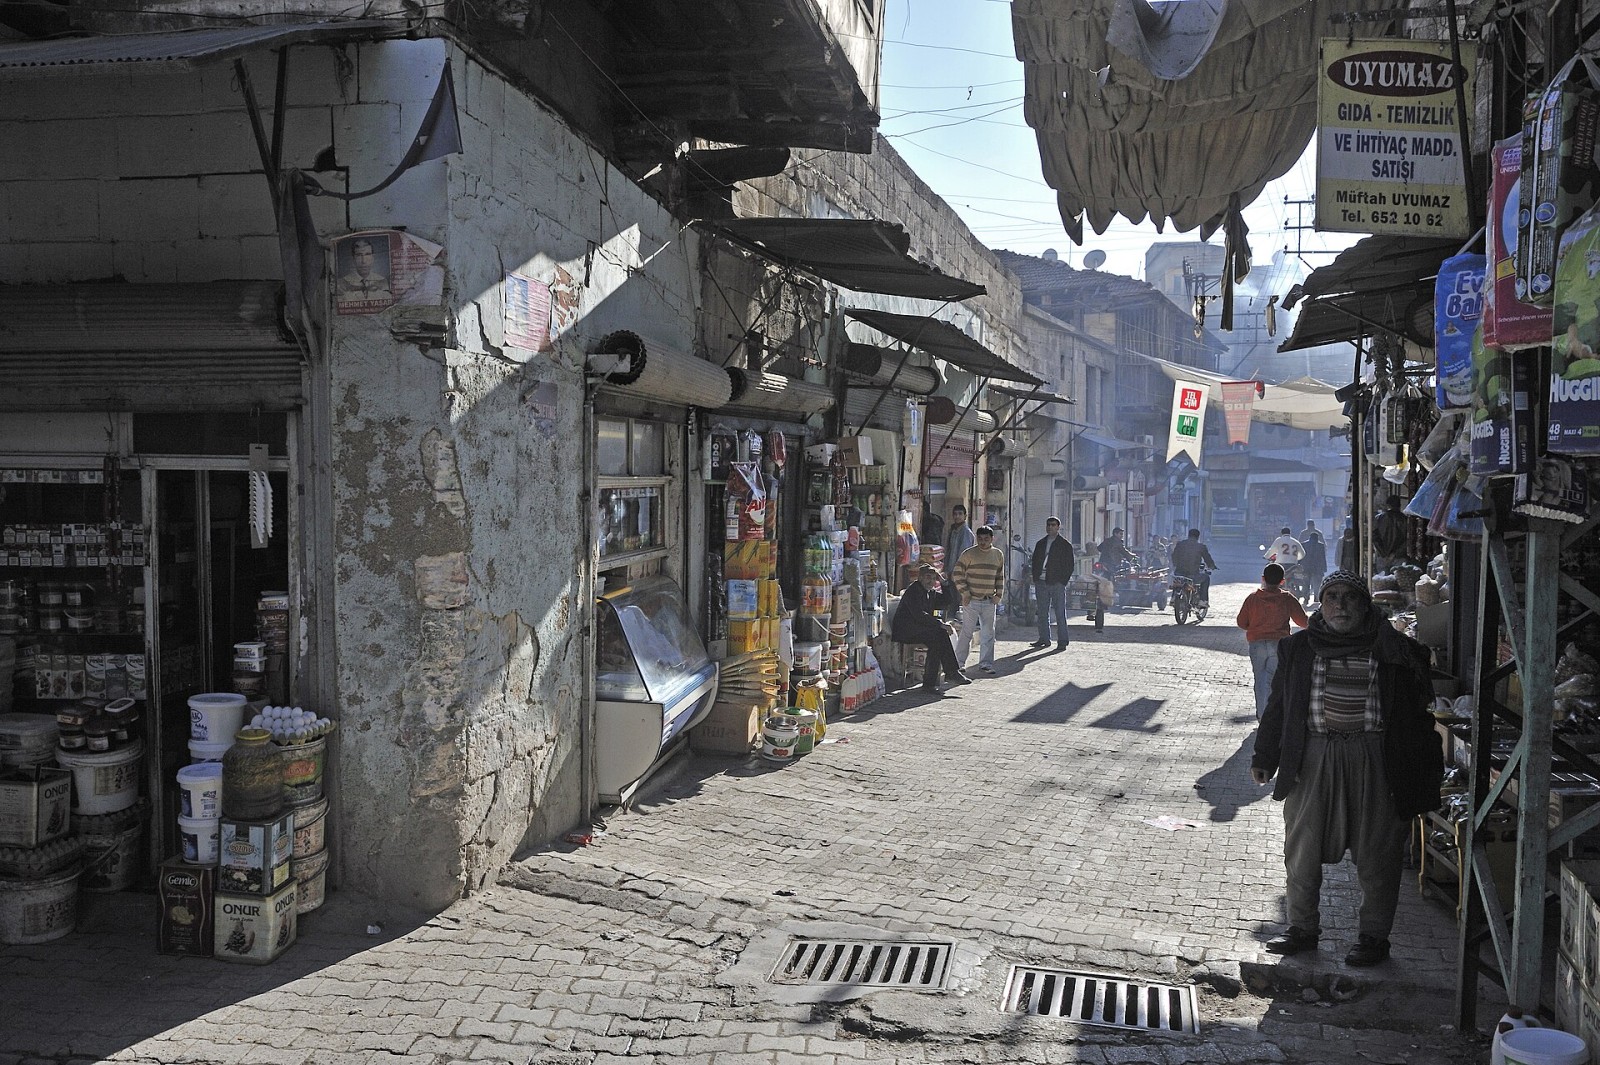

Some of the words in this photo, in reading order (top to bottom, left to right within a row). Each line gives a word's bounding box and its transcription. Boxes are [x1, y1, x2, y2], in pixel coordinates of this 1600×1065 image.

[1343, 60, 1455, 88] UYUMAZ
[1337, 103, 1373, 123] GIDA
[1387, 99, 1455, 126] TEMİZLİK
[1334, 133, 1353, 151] VE
[1355, 129, 1407, 160] İHTİYAÇ
[1411, 137, 1458, 157] MADD.
[1371, 159, 1416, 184] SATIŞI
[1336, 189, 1387, 205] Müftah
[1391, 194, 1451, 209] UYUMAZ
[1341, 209, 1366, 224] Tel.
[1370, 211, 1398, 225] 652
[1403, 212, 1421, 226] 10
[1425, 213, 1444, 227] 62
[1186, 391, 1198, 400] TEL
[1549, 373, 1600, 403] HUGGI
[1181, 425, 1195, 436] CEP
[1183, 416, 1195, 426] MY
[1549, 423, 1561, 435] 48
[712, 442, 720, 468] PEDO
[1498, 427, 1511, 465] HUGGIES
[1281, 543, 1298, 557] 22
[44, 783, 69, 799] ONUR
[222, 903, 261, 916] ONUR
[275, 892, 295, 913] ONUR
